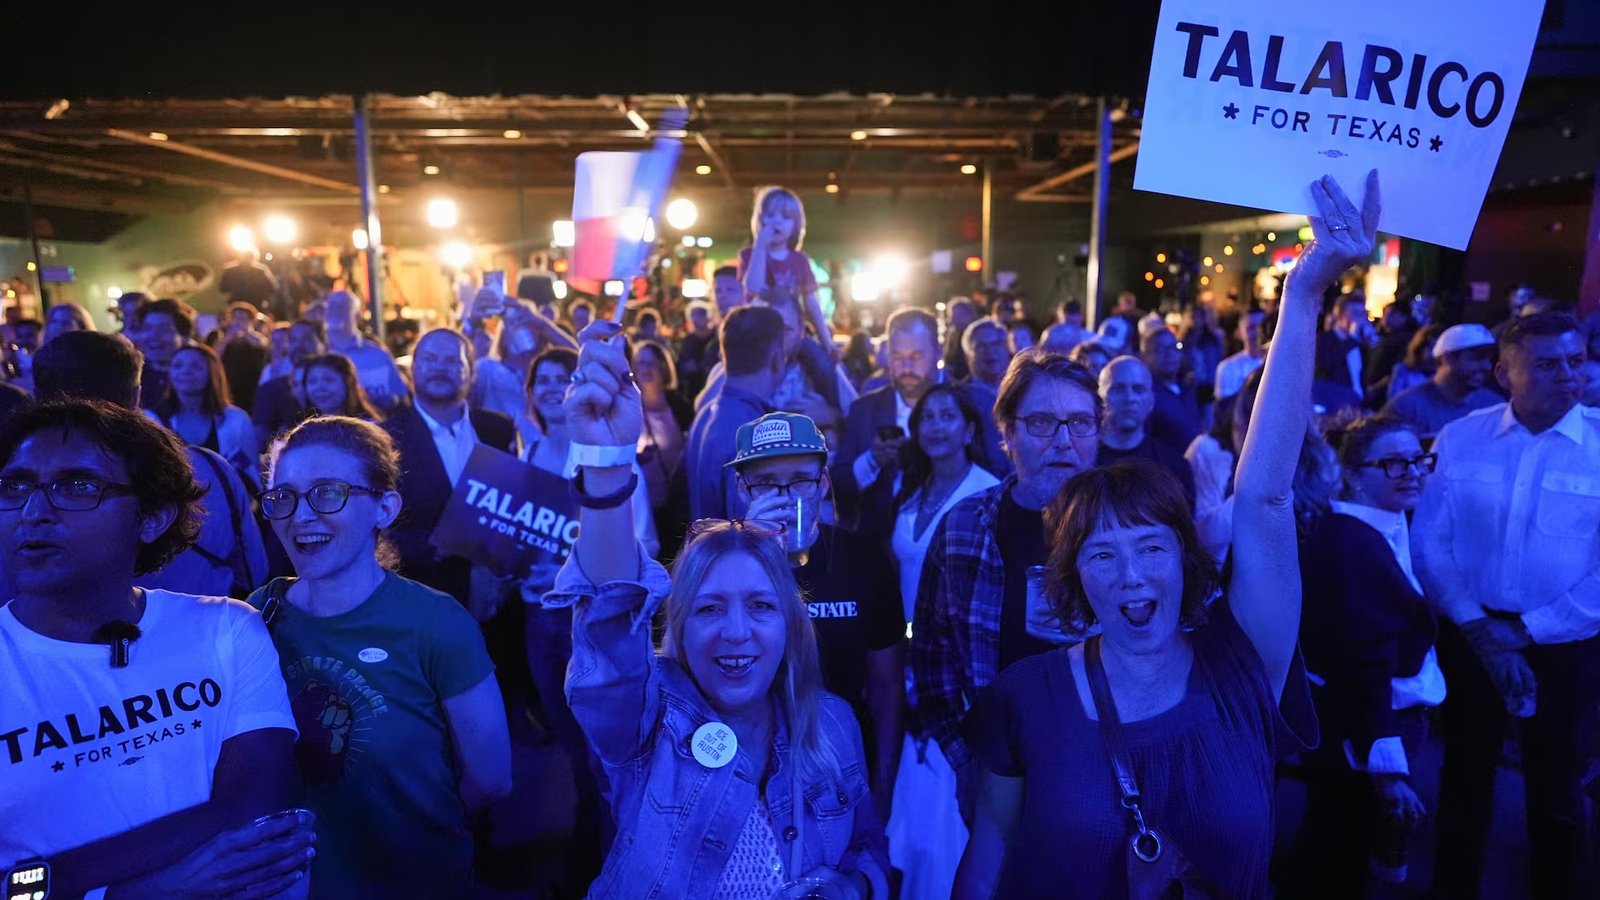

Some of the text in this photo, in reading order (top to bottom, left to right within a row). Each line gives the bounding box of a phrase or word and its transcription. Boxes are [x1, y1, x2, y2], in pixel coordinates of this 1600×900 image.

[1176, 22, 1505, 128] TALARICO
[1252, 105, 1421, 149] FOR TEXAS
[465, 478, 581, 545] TALARIC
[490, 519, 559, 555] FOR TEXAS
[804, 601, 858, 618] STATE
[0, 678, 222, 764] TALARICO
[715, 728, 729, 742] ICE
[74, 745, 112, 768] FOR
[117, 723, 185, 754] TEXAS
[697, 740, 722, 762] AUSTIN
[703, 732, 728, 752] OUT OF
